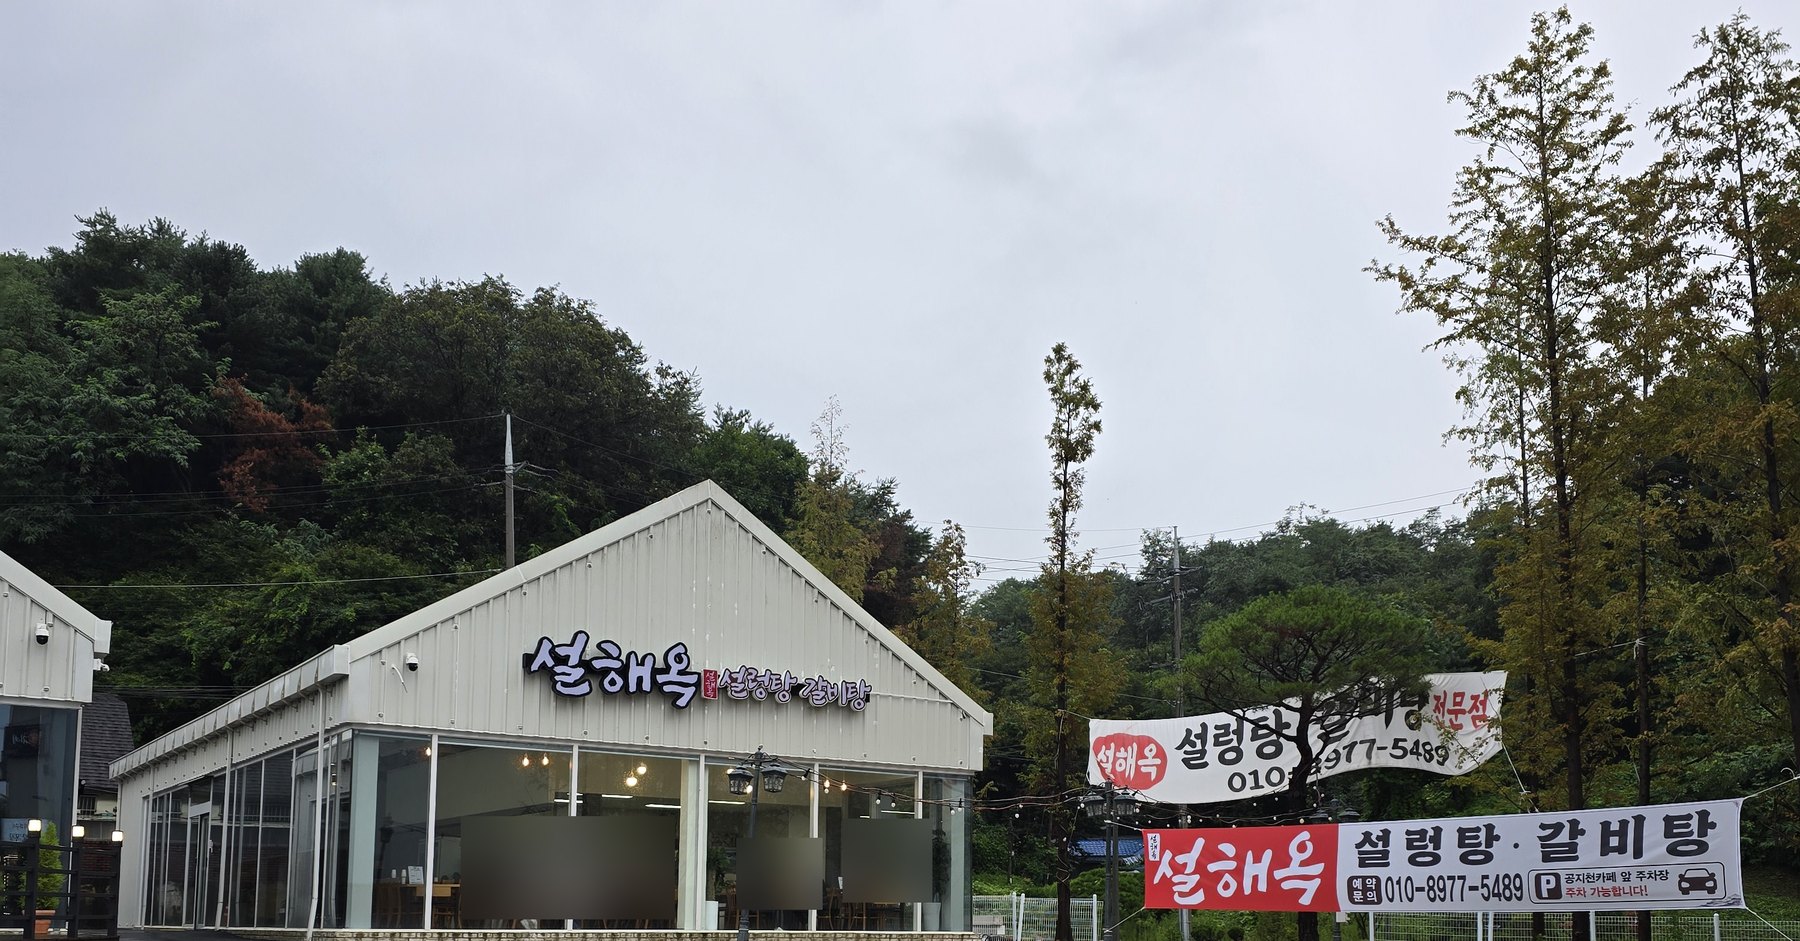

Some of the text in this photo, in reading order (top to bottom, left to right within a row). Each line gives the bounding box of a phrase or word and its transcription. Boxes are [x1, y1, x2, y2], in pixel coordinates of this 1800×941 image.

[528, 630, 700, 708] 설해옥
[718, 664, 874, 712] 설렁탕 갈비탕
[1174, 708, 1292, 770] 설렁탕
[1432, 688, 1488, 731] 전문점
[1096, 741, 1162, 782] 설해옥
[1153, 830, 1325, 905] 설해옥
[1384, 872, 1523, 903] 010-8977-5489
[1564, 869, 1669, 884] 공지천카페 앞 주차장
[1565, 885, 1648, 898] 주차 가능합니다!
